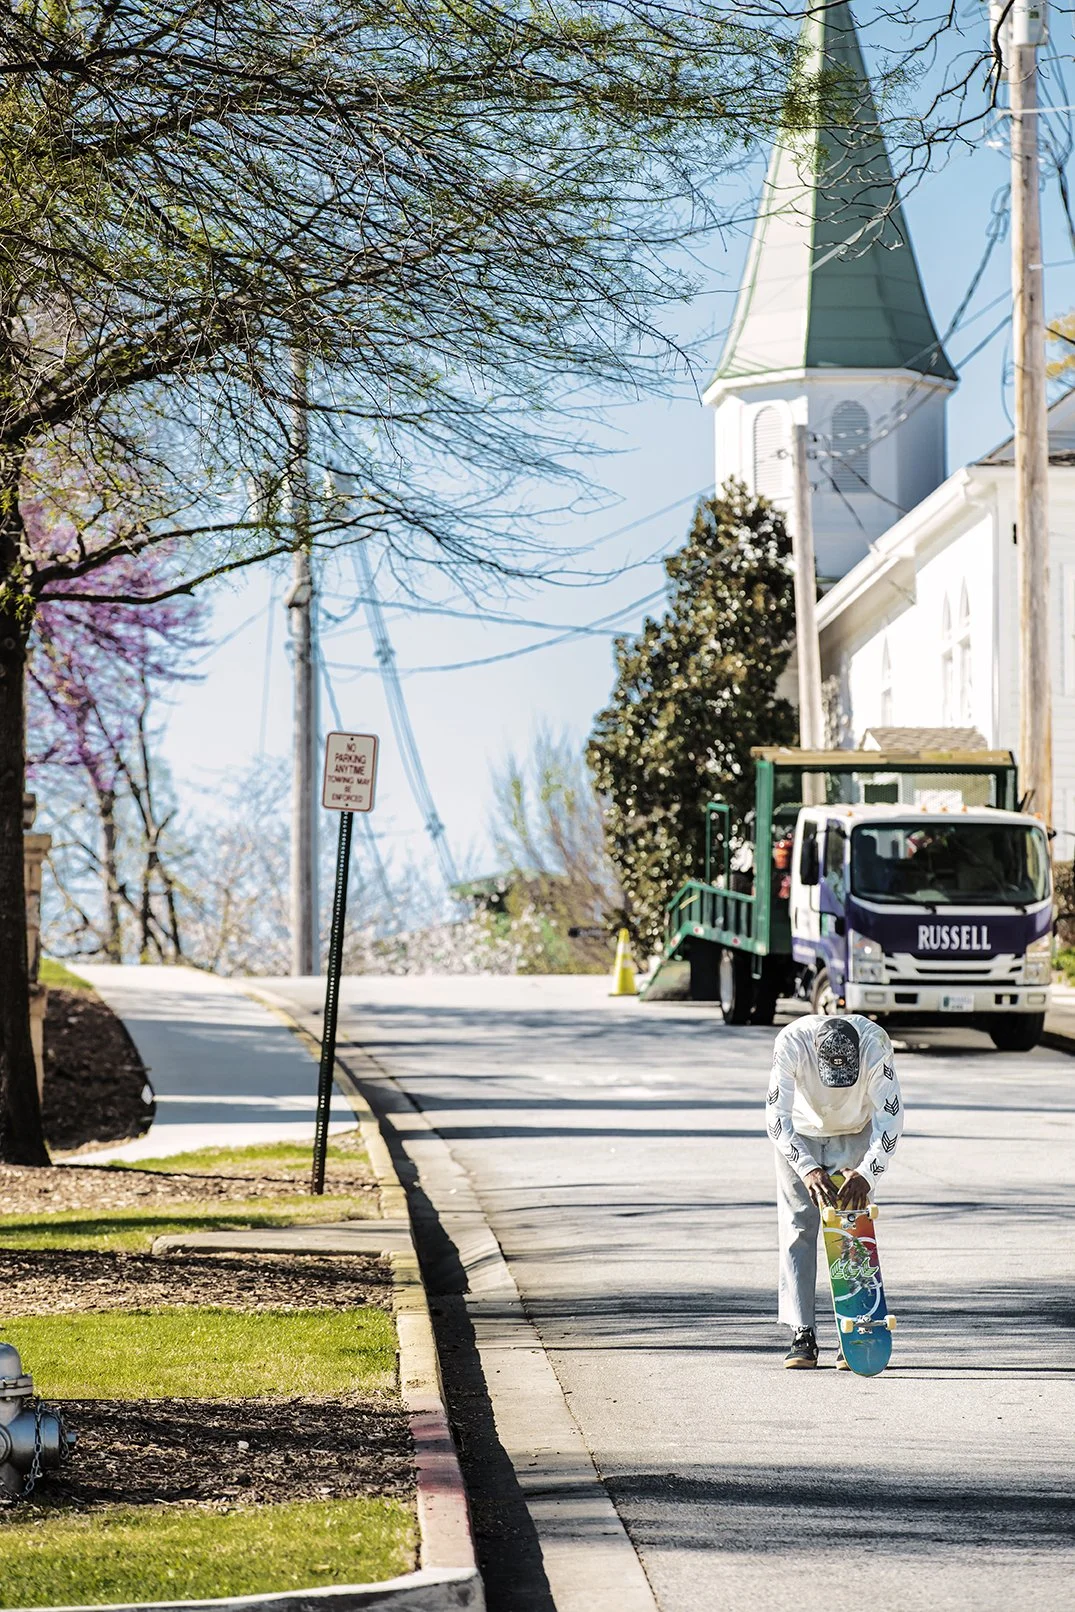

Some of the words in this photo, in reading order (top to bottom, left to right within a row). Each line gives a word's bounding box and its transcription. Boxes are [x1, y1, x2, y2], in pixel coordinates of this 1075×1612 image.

[347, 743, 356, 752] NO
[335, 753, 366, 764] PARKING
[334, 764, 365, 775] ANYTIME
[327, 775, 354, 784] TOWING
[331, 793, 363, 803] ENFORCED
[918, 925, 991, 950] RUSSELL
